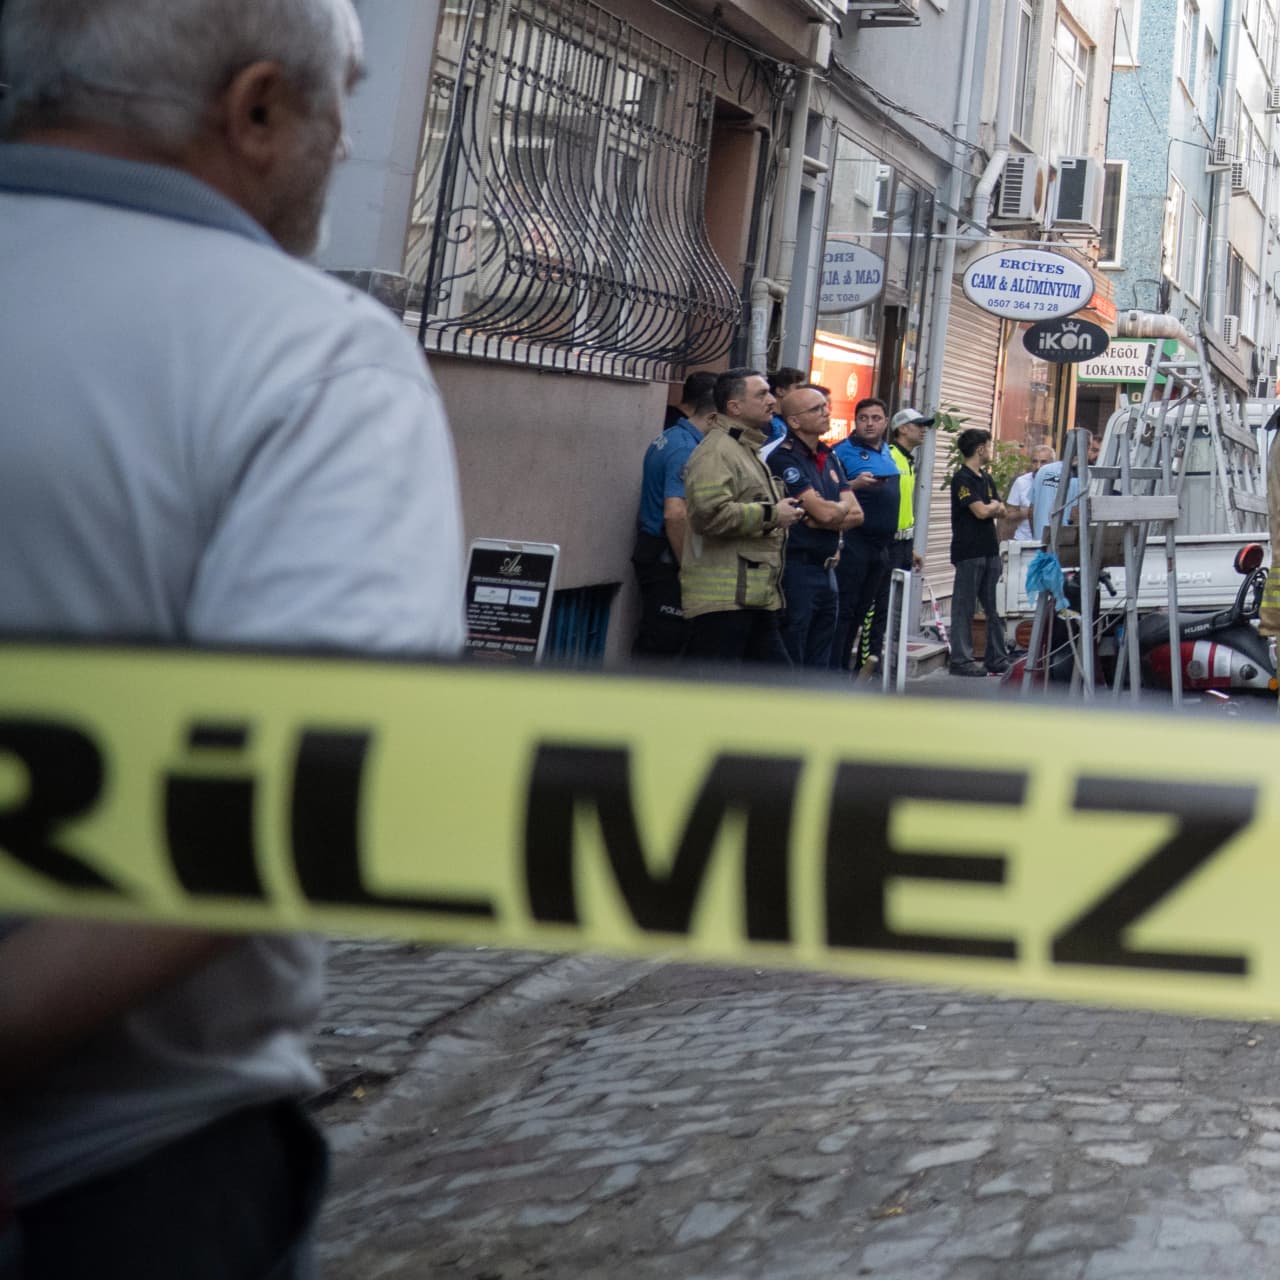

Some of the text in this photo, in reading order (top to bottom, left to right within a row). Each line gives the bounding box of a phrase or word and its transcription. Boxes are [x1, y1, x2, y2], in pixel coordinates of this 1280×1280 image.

[1000, 258, 1065, 275] ERCİYES
[971, 272, 1082, 299] CAM & ALÜMİNYUM
[987, 298, 1059, 312] 0507 364 73 28
